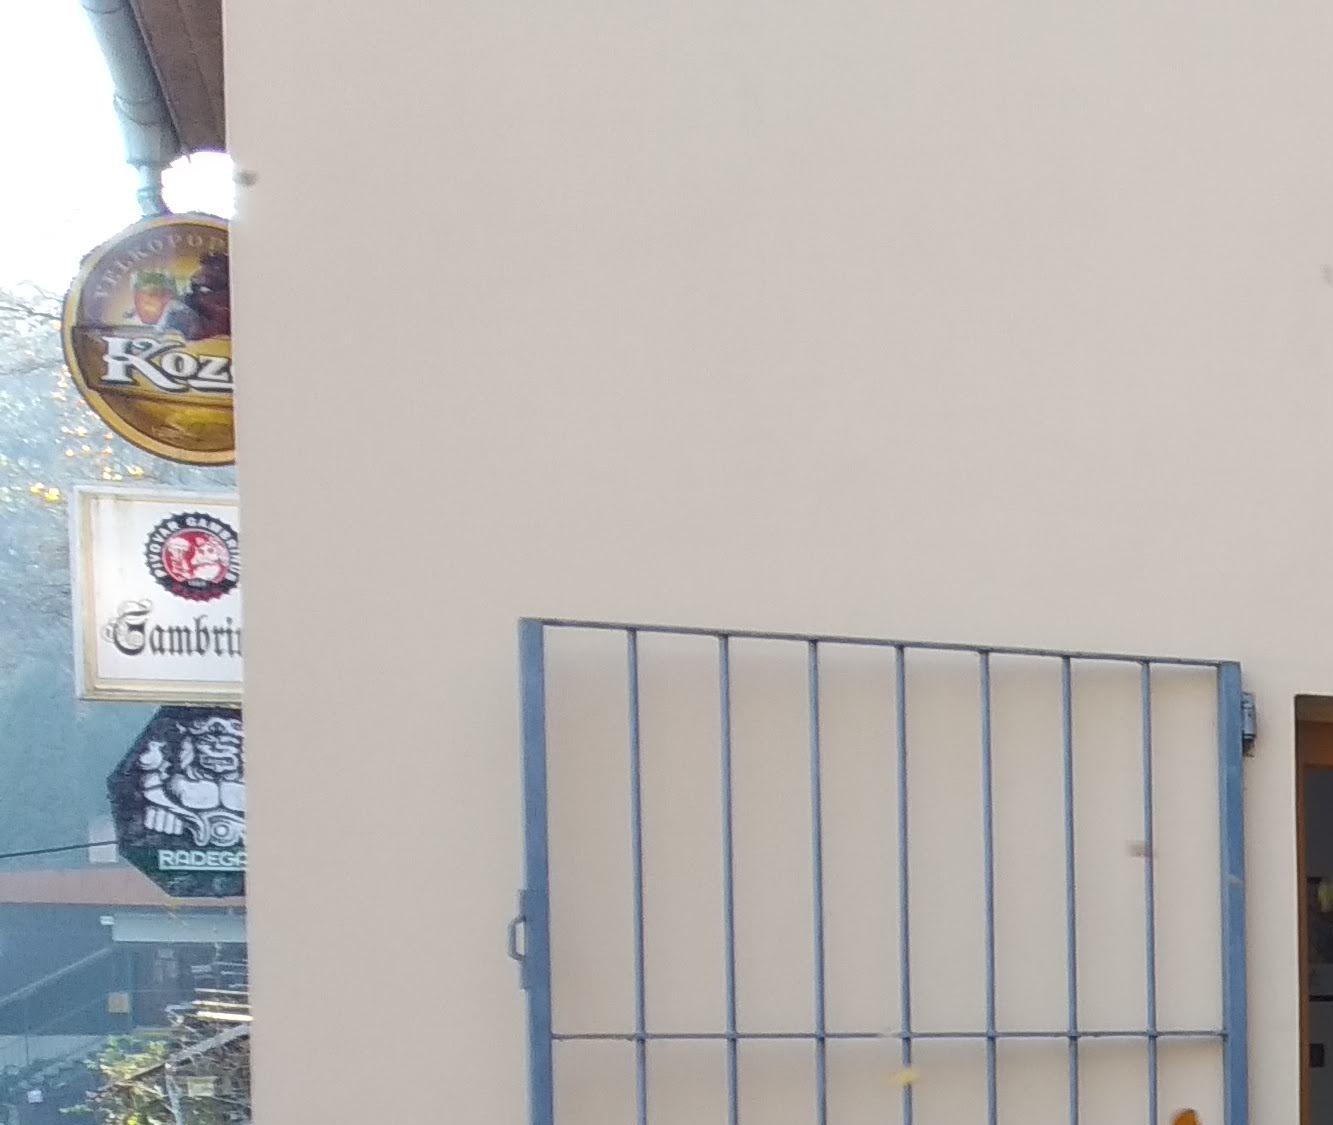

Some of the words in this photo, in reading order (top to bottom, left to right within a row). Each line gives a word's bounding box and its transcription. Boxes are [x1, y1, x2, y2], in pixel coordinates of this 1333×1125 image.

[95, 232, 228, 301] VELKOPOP
[101, 336, 234, 392] Koz
[149, 520, 181, 578] PIVOVAR
